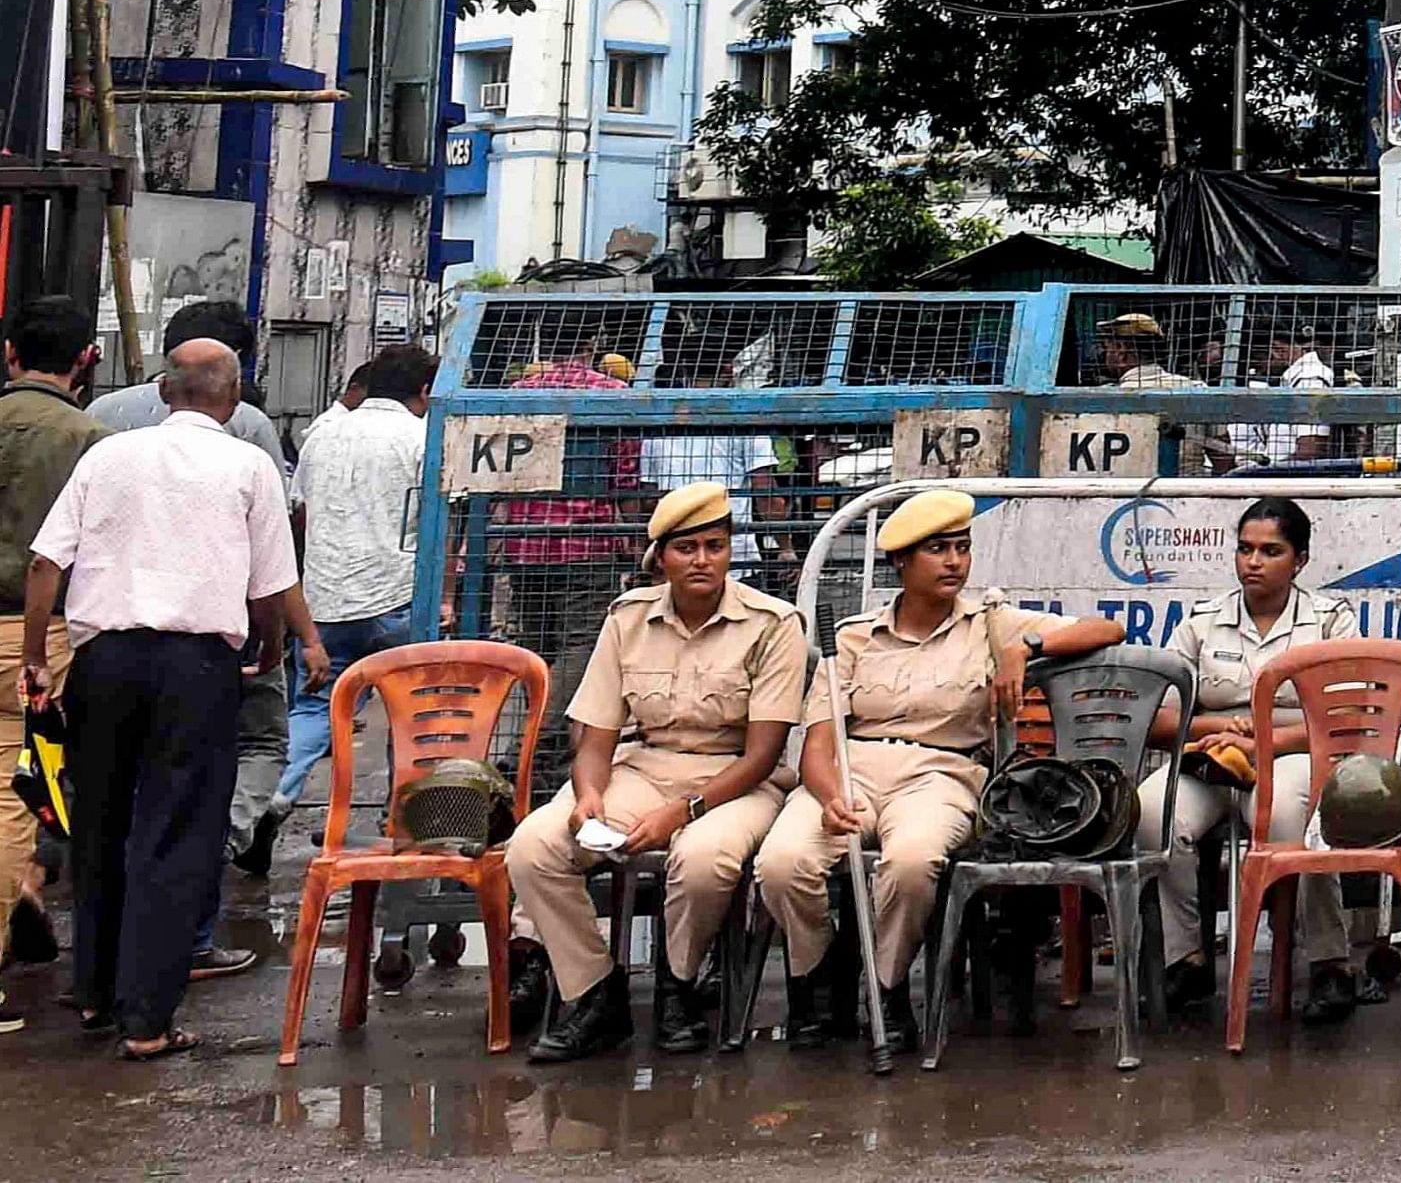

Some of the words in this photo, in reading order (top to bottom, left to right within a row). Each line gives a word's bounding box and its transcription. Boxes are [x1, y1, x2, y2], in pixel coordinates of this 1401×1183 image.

[446, 138, 470, 165] NCES
[471, 433, 533, 474] KP
[921, 427, 981, 466] KP
[1068, 432, 1130, 471] KP
[1124, 528, 1225, 548] SUPERSHAKTI
[1123, 549, 1225, 562] Foundation
